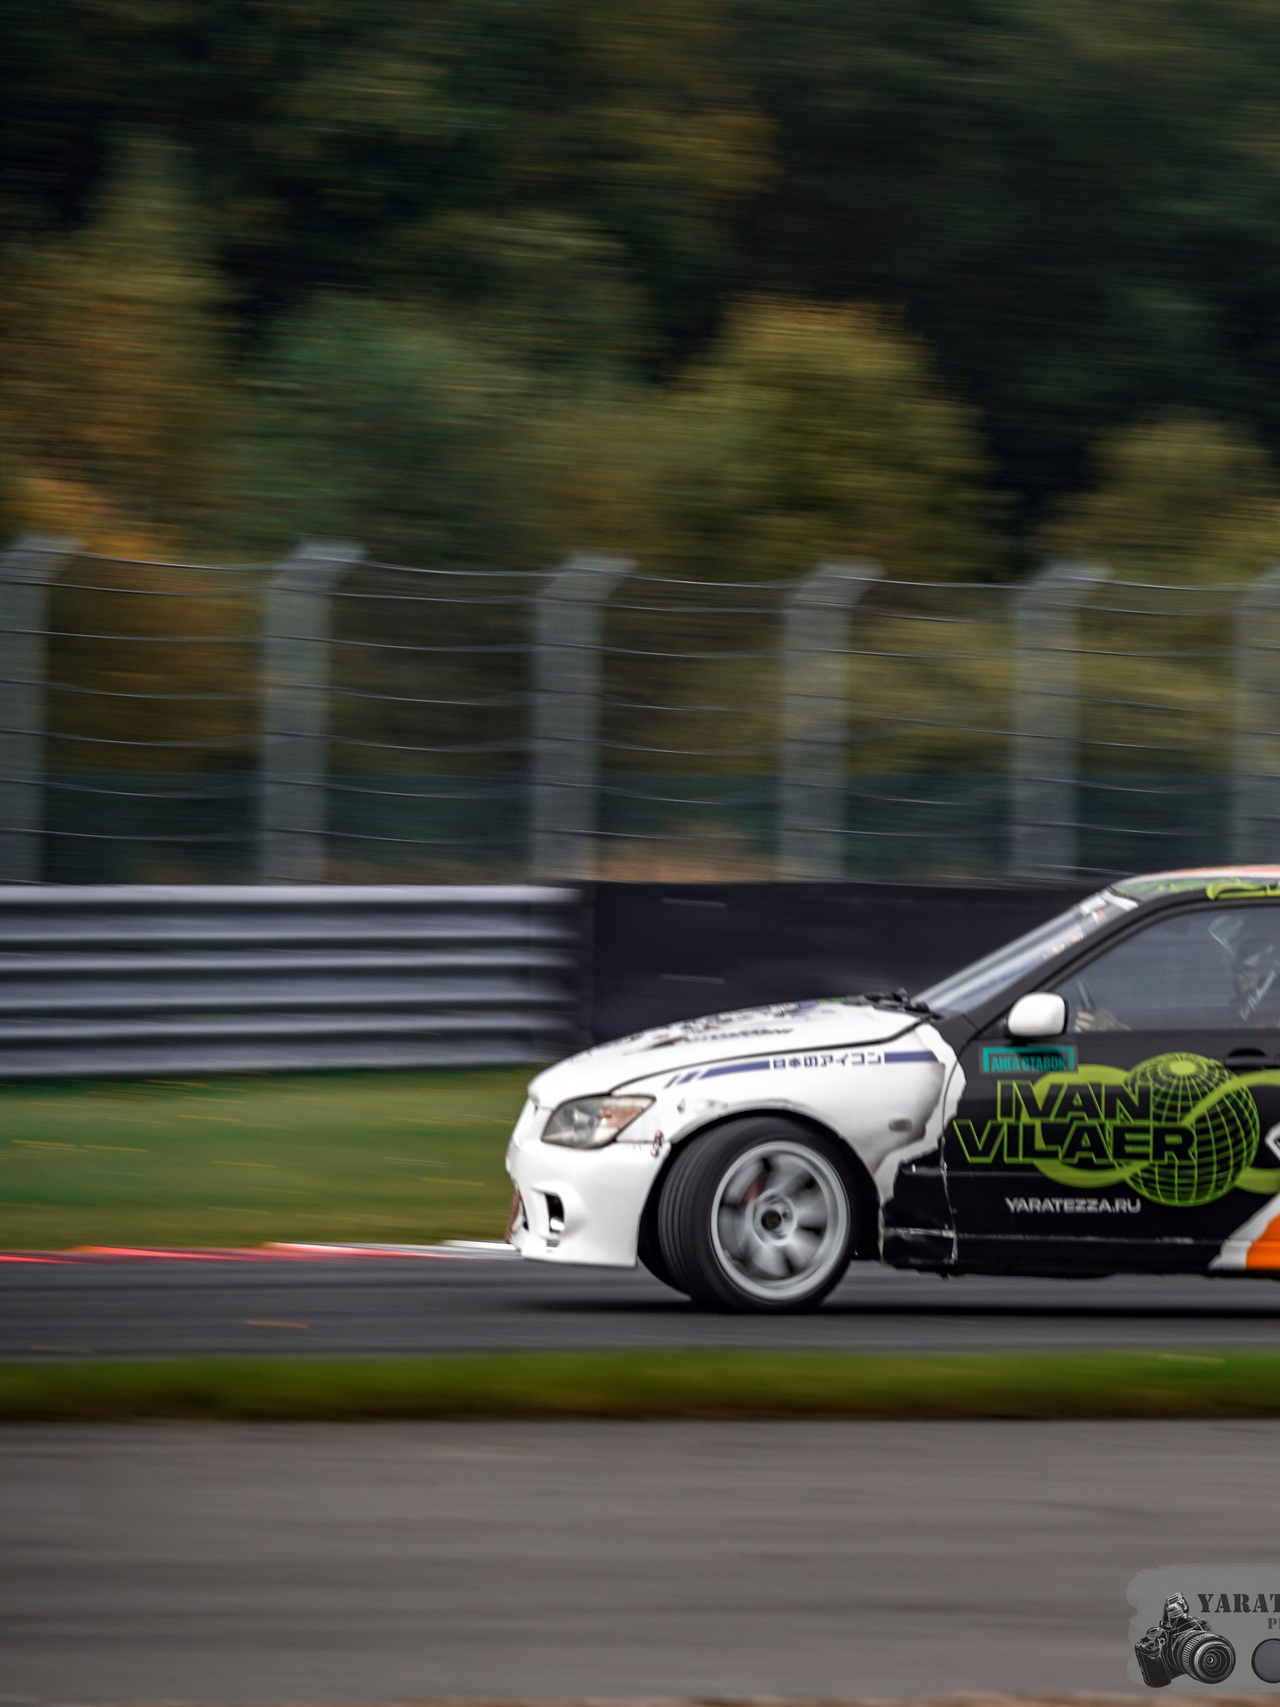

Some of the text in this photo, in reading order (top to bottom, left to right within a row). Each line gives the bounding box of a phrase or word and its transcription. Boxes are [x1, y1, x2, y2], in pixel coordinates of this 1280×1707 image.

[997, 1079, 1153, 1123] IVAN
[953, 1119, 1197, 1164] VILAER
[1005, 1197, 1142, 1213] YARATEZZA.RU
